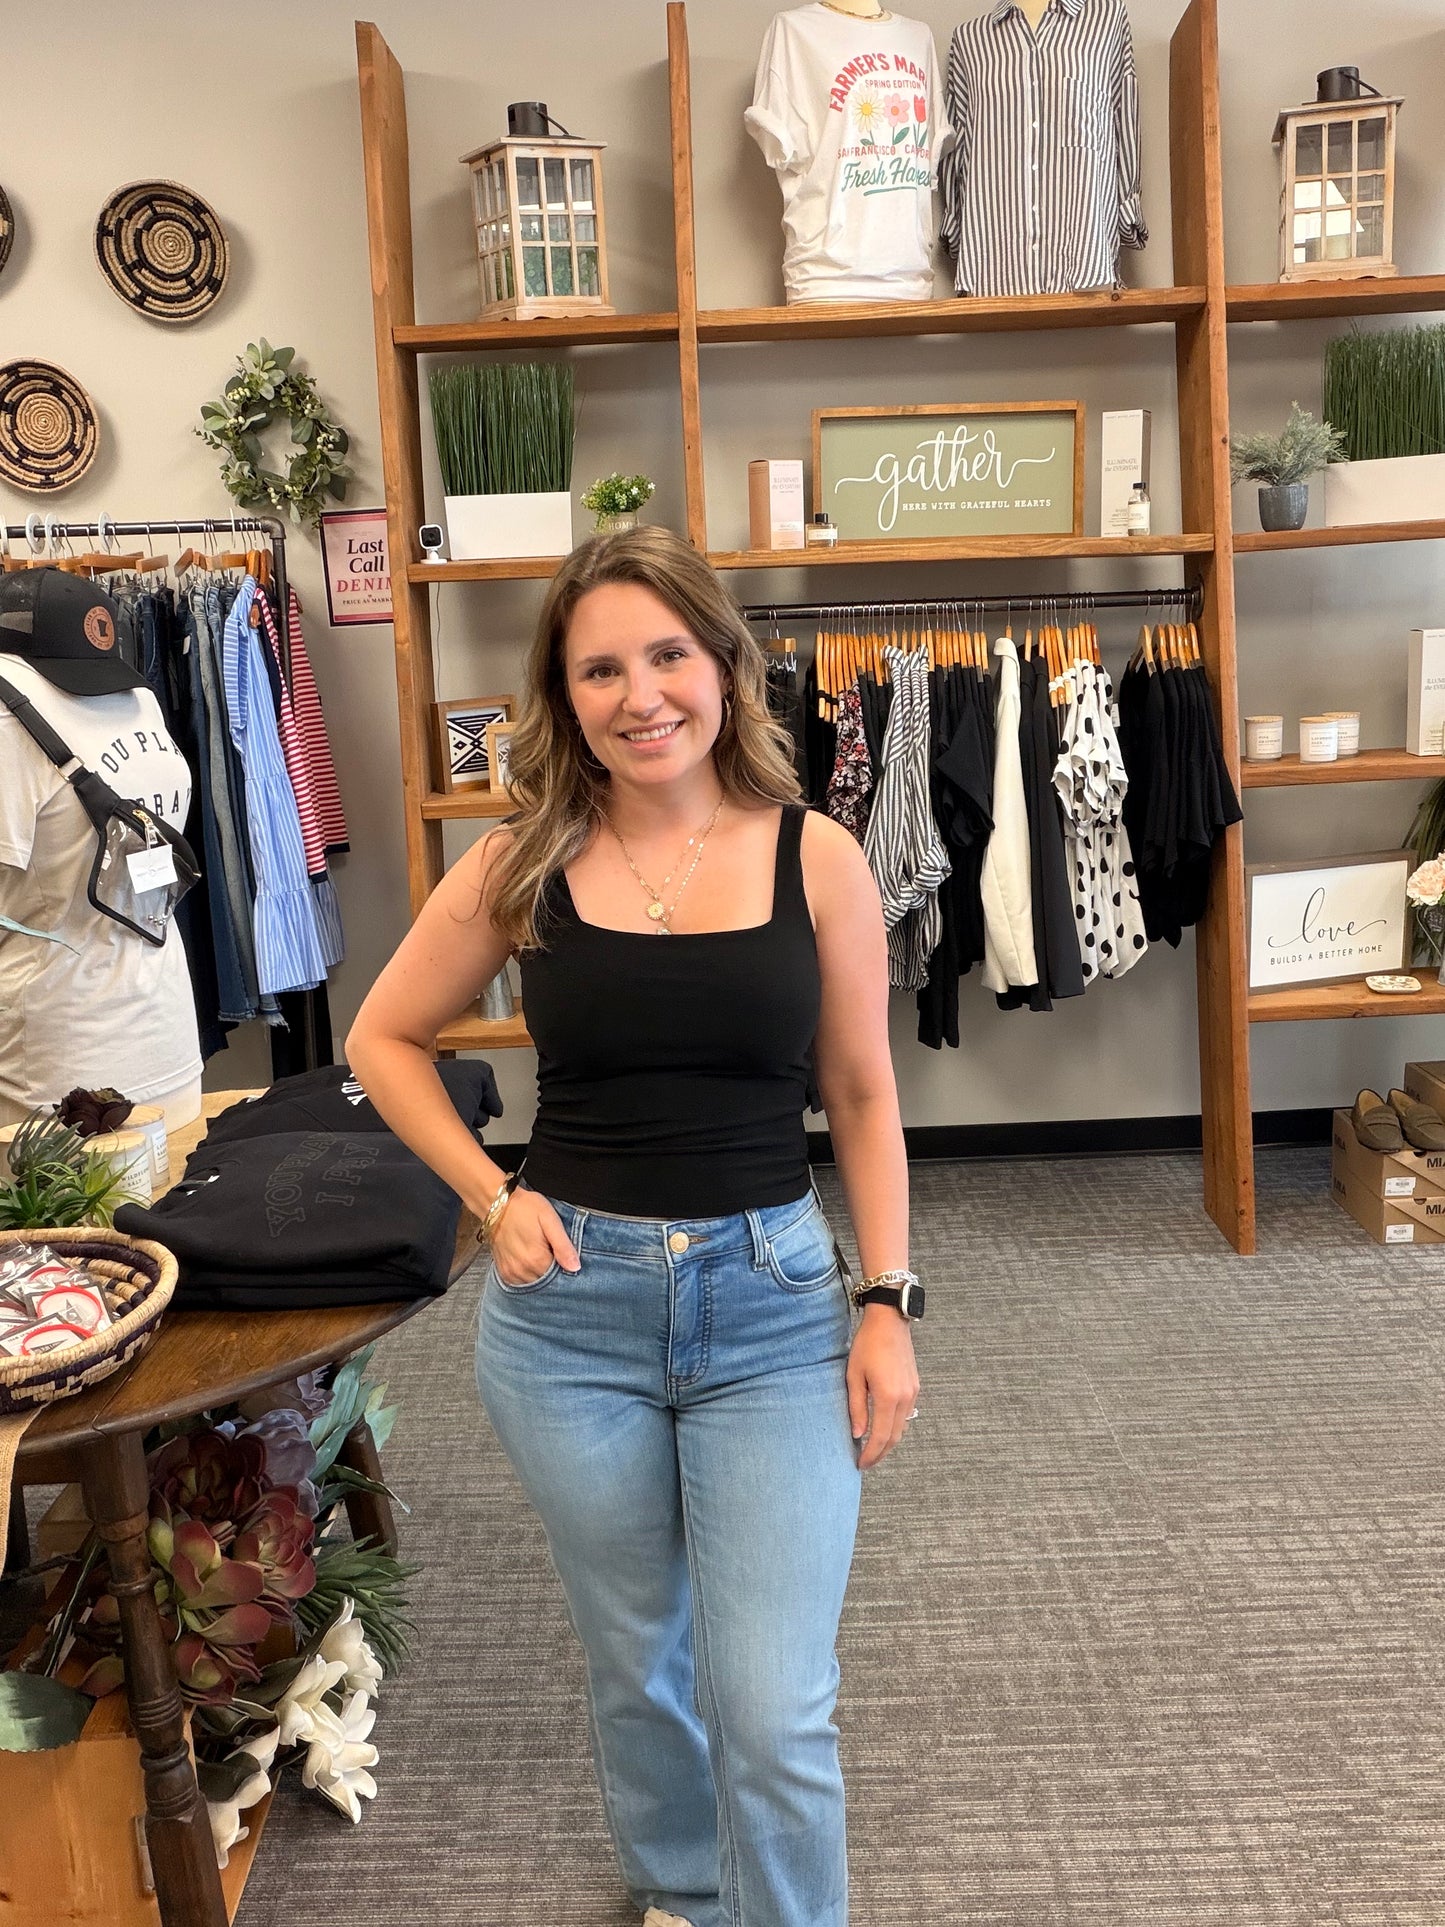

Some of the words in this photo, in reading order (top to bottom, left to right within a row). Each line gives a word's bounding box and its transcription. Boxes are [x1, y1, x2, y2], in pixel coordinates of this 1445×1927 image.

[829, 52, 890, 113] FARMER'S
[865, 79, 892, 89] SPRING
[841, 161, 888, 193] Fresh
[834, 424, 1056, 532] gather
[902, 502, 927, 511] HERE
[931, 501, 956, 510] WITH
[960, 500, 1010, 509] GRATEFUL
[1014, 498, 1052, 508] HEARTS
[346, 538, 384, 554] Last
[349, 555, 384, 573] Call
[99, 737, 131, 774] OU
[1267, 886, 1388, 949] love
[1270, 954, 1303, 966] BUILDS
[1307, 953, 1313, 961] A
[1318, 948, 1353, 960] BETTER
[1358, 944, 1383, 954] HOME
